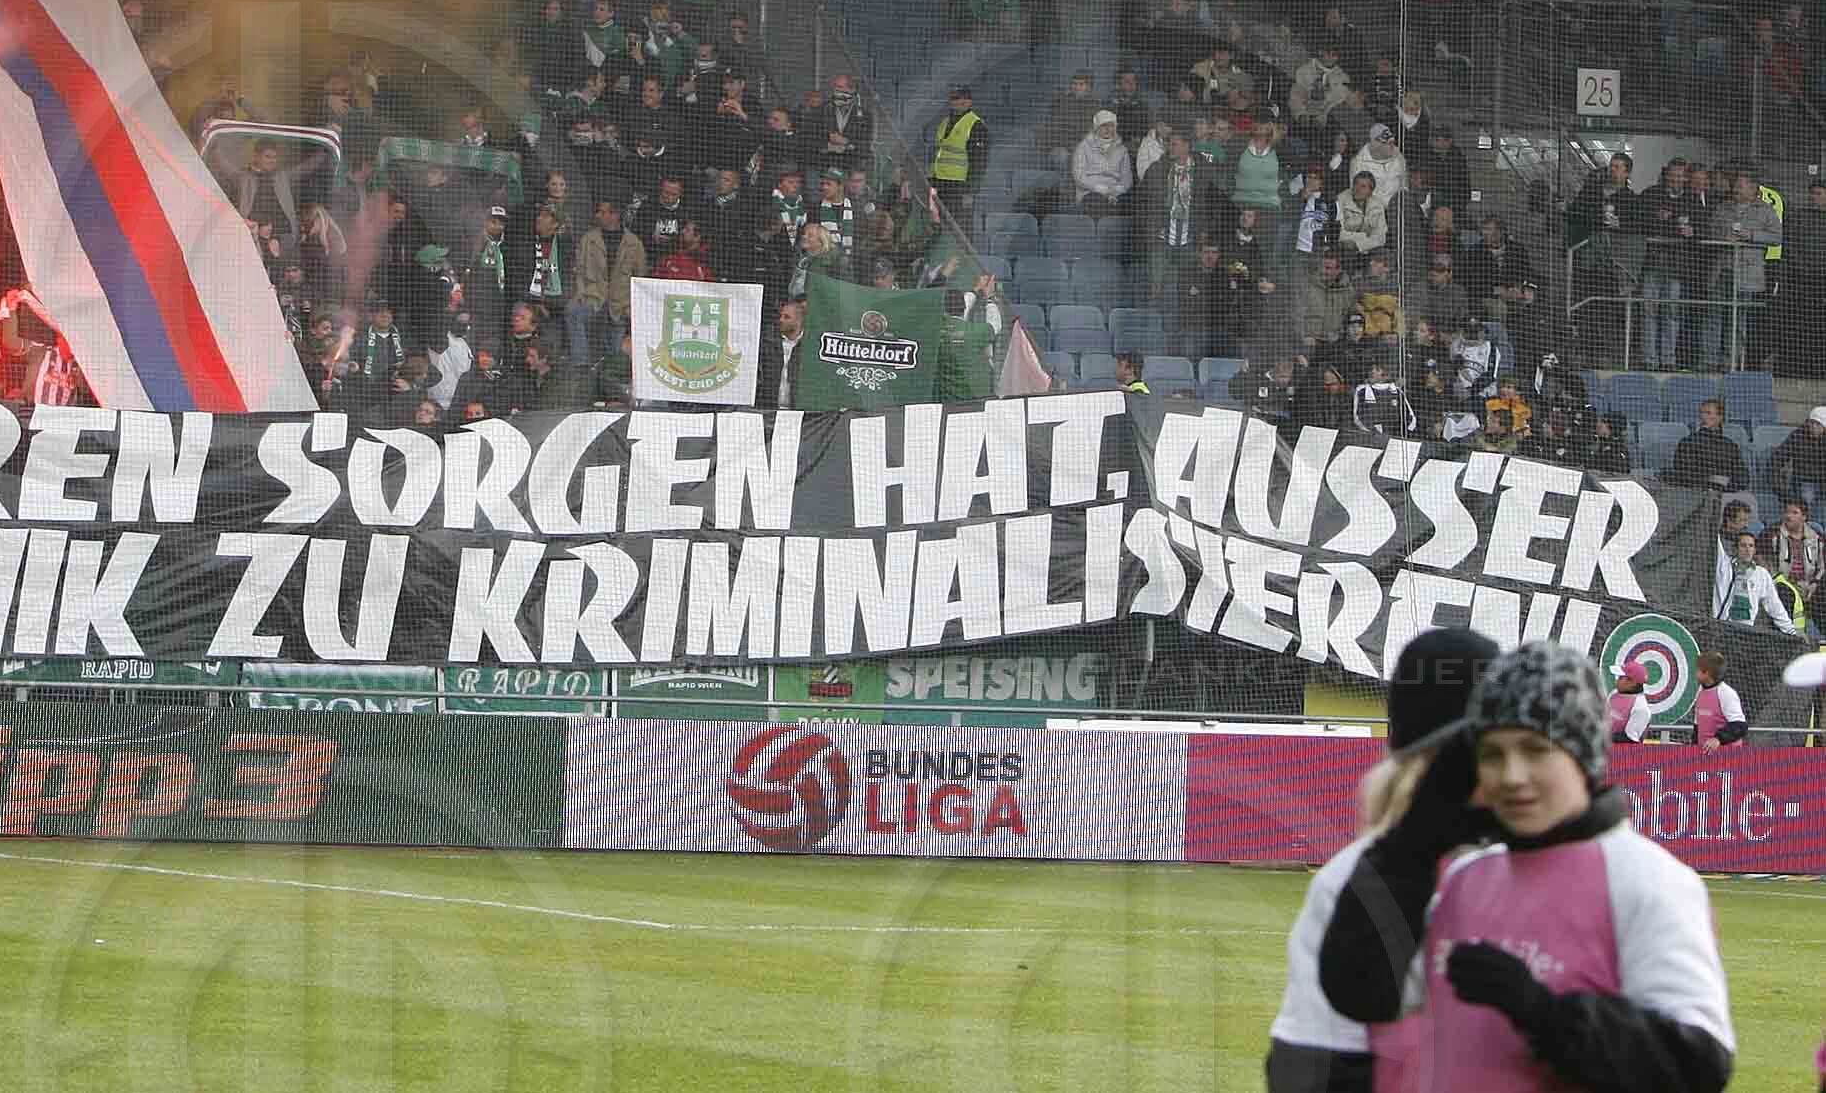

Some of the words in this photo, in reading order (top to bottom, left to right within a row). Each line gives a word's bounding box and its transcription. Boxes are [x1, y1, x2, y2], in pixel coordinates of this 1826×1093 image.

[1584, 77, 1613, 108] 25
[824, 338, 913, 364] Hütteldorf
[257, 410, 804, 535] SORGEN
[1153, 407, 1659, 603] AUSSER
[205, 531, 410, 662] ZU
[80, 660, 155, 680] RAPID
[456, 666, 592, 703] RAPID
[864, 749, 1024, 783] BUNDES
[864, 782, 1028, 838] LIGA
